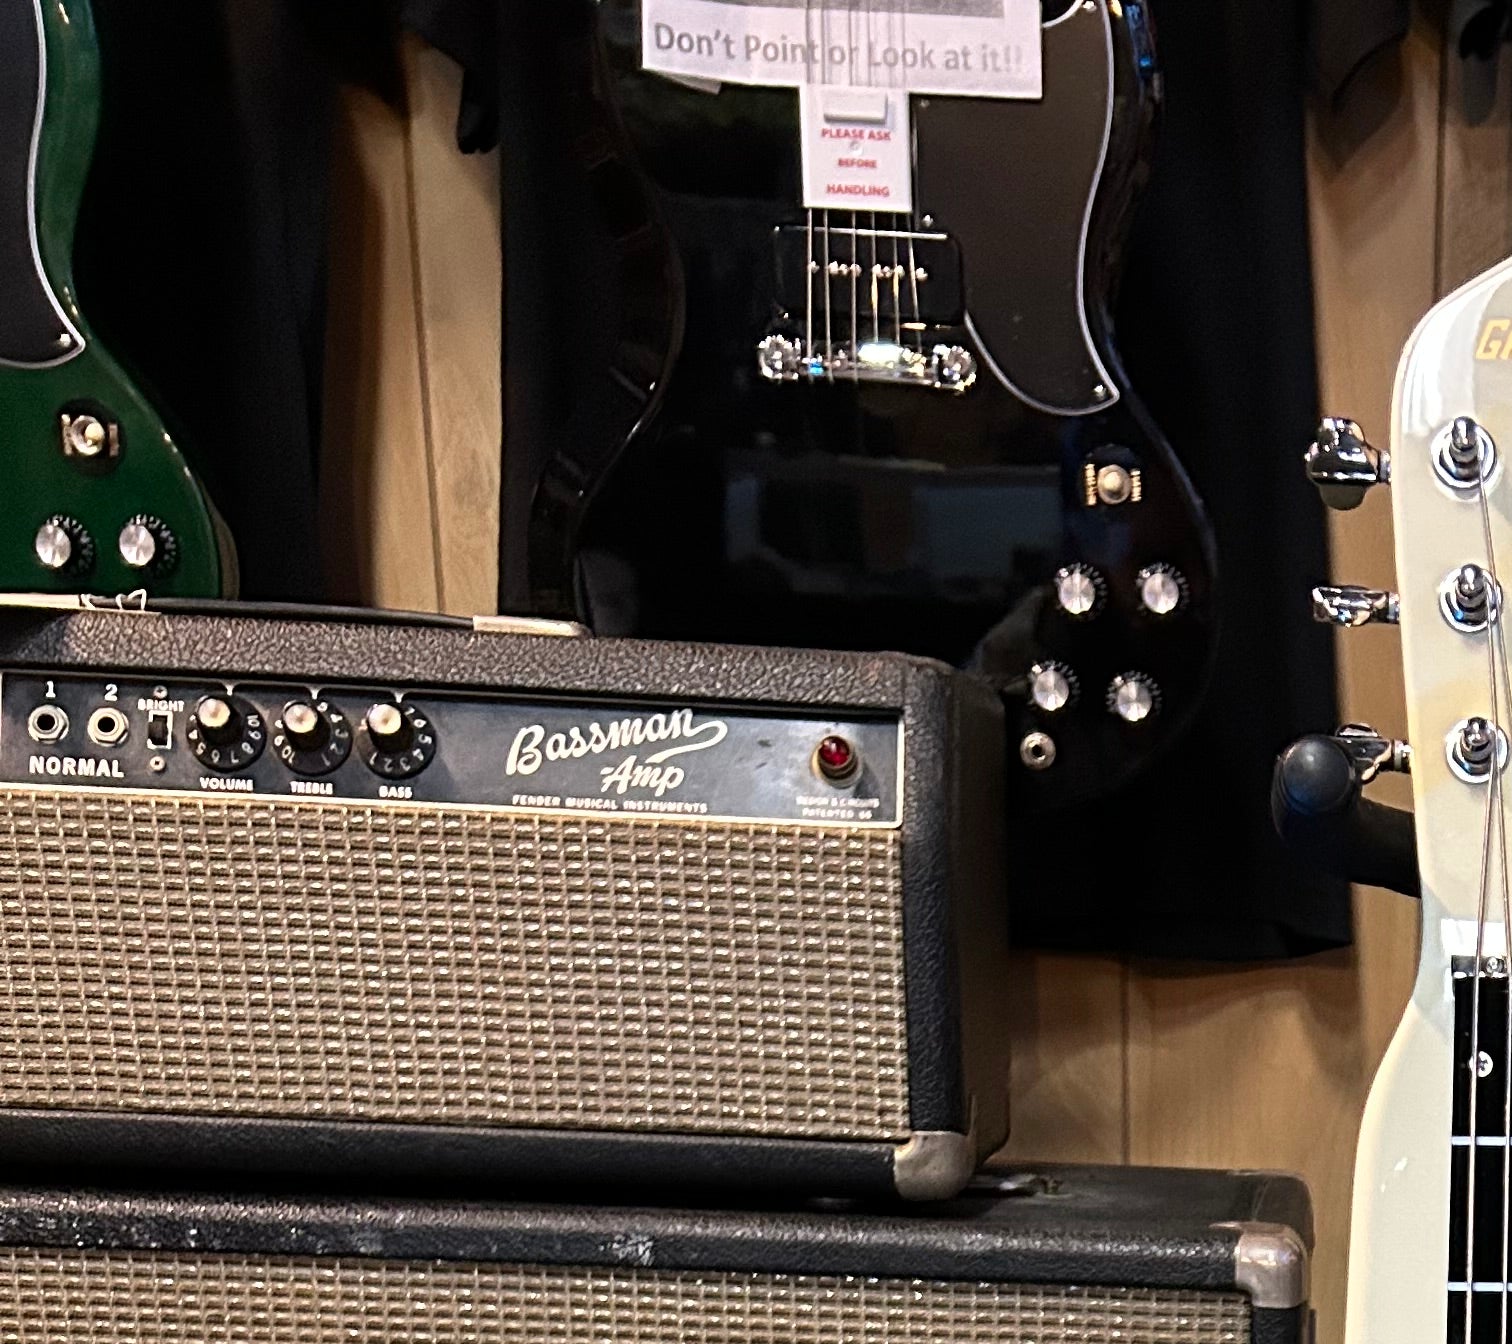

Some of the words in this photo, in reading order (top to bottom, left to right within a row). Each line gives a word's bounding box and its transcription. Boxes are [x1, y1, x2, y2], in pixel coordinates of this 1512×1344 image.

[655, 22, 735, 60] Don't
[745, 35, 819, 65] Point
[828, 45, 858, 65] or
[868, 41, 936, 69] Look
[944, 46, 972, 70] at
[821, 127, 865, 140] PLEASE
[868, 129, 892, 141] ASK
[838, 157, 877, 169] BEFORE
[826, 183, 890, 198] HANDLING
[45, 680, 56, 698] 1
[104, 683, 118, 702] 2
[138, 698, 185, 713] BRIGHT
[505, 707, 728, 776] Bassman
[29, 755, 125, 778] NORMAL
[600, 755, 685, 797] Amp
[200, 777, 254, 791] VOLUME
[290, 781, 333, 795] TREBLE
[379, 785, 413, 799] BASS
[512, 794, 561, 807] FENDER
[565, 797, 618, 810] MUSICAL
[623, 800, 708, 814] INSTRUMENTS
